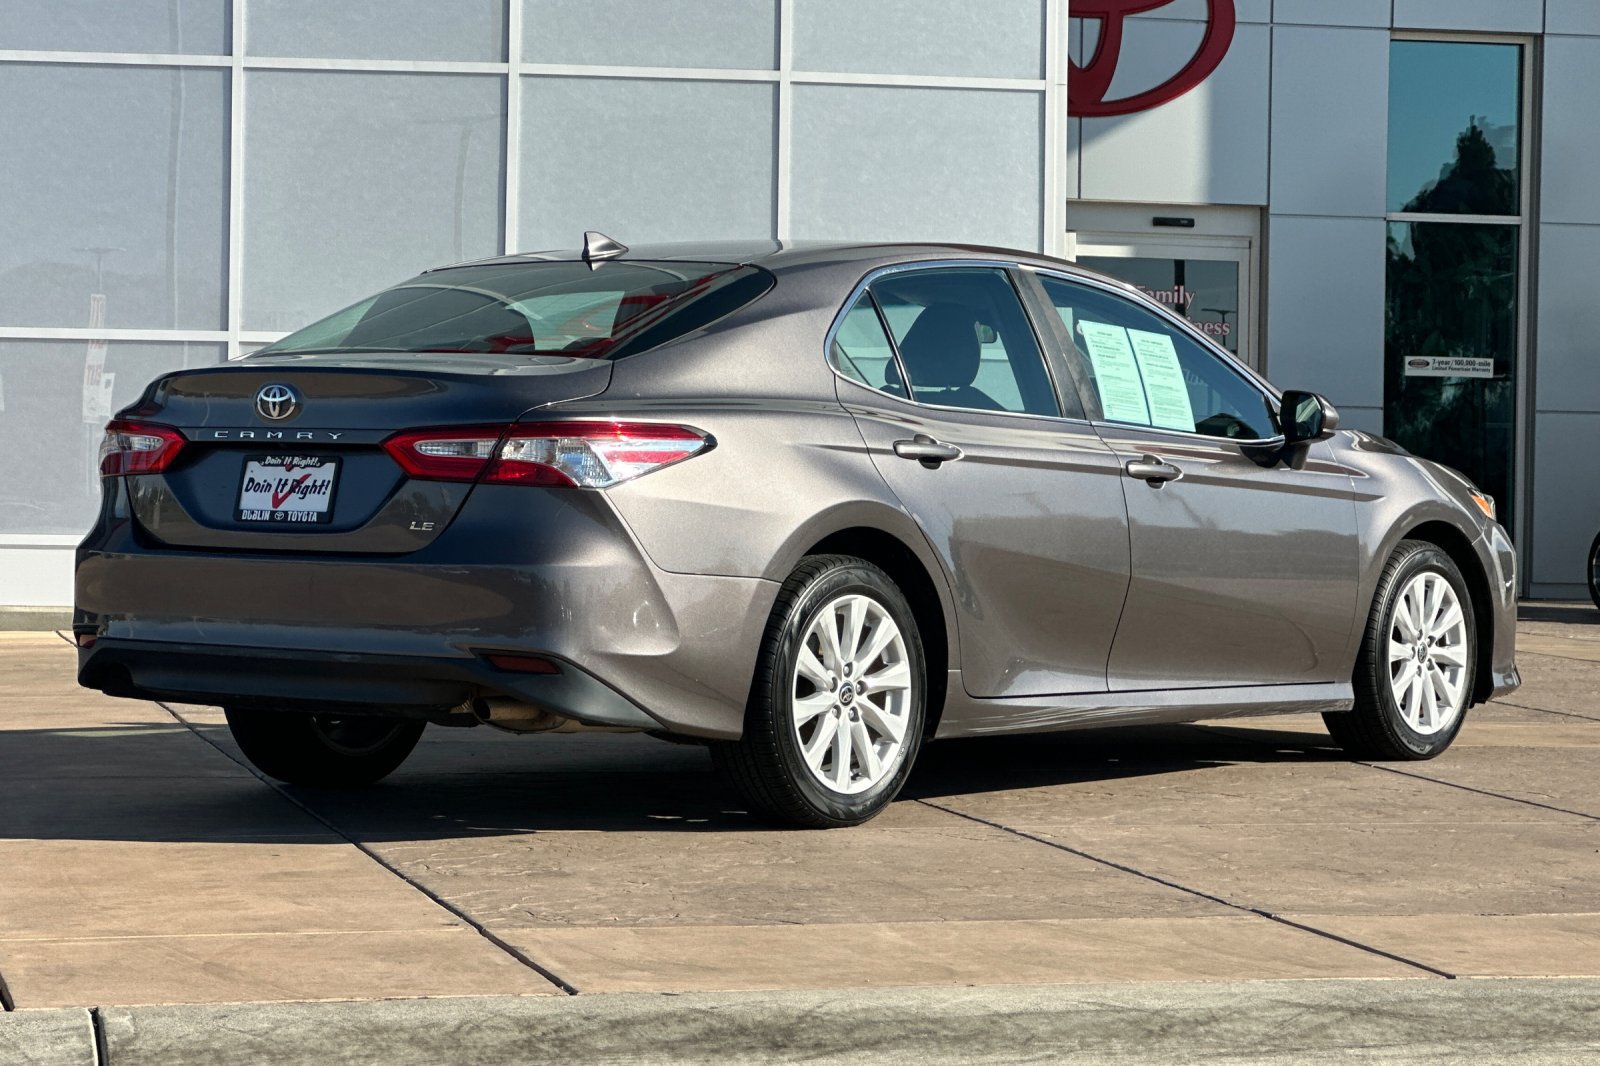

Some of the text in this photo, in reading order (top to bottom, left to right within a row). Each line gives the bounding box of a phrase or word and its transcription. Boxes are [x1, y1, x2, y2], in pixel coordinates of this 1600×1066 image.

[1136, 285, 1195, 310] amily
[214, 430, 342, 440] CAMRY
[265, 456, 318, 468] Doin' It Right!
[244, 477, 331, 499] Doin' It Right!
[241, 510, 317, 522] DUBLIN TOYOTA
[409, 521, 434, 531] LE
